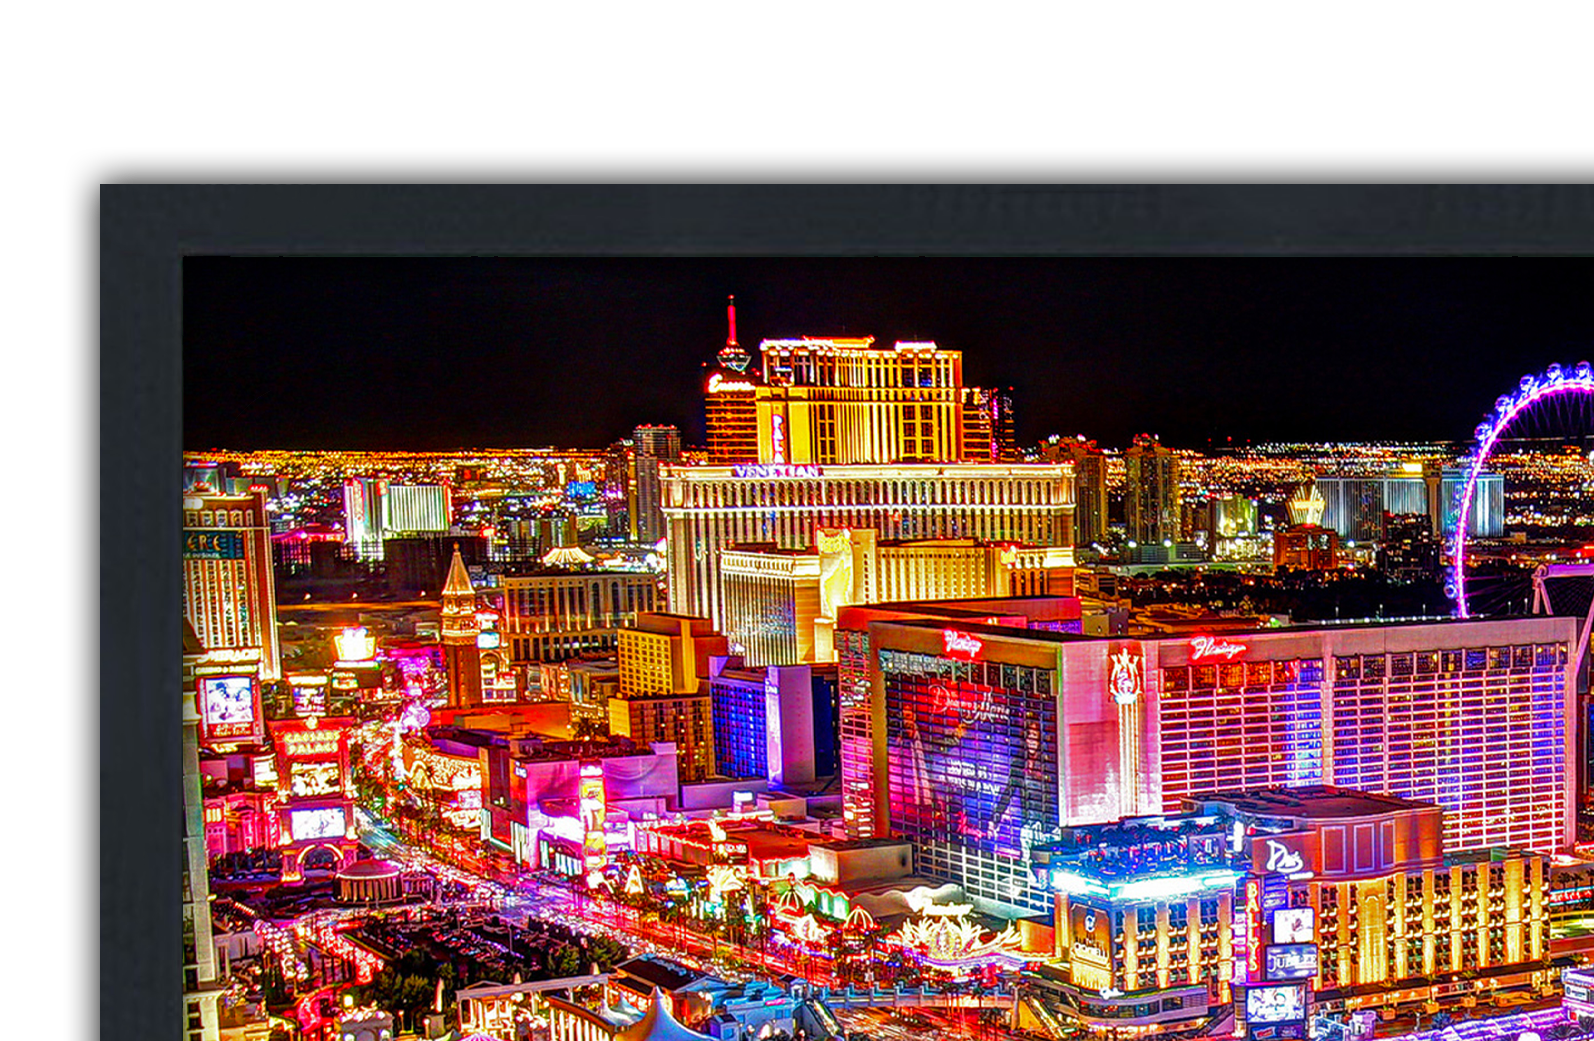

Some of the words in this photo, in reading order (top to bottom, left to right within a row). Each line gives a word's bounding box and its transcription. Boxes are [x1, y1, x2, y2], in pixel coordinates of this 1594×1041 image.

[733, 464, 820, 478] VENETIAN
[1190, 635, 1247, 660] Flamingo
[283, 730, 341, 744] CAESARS
